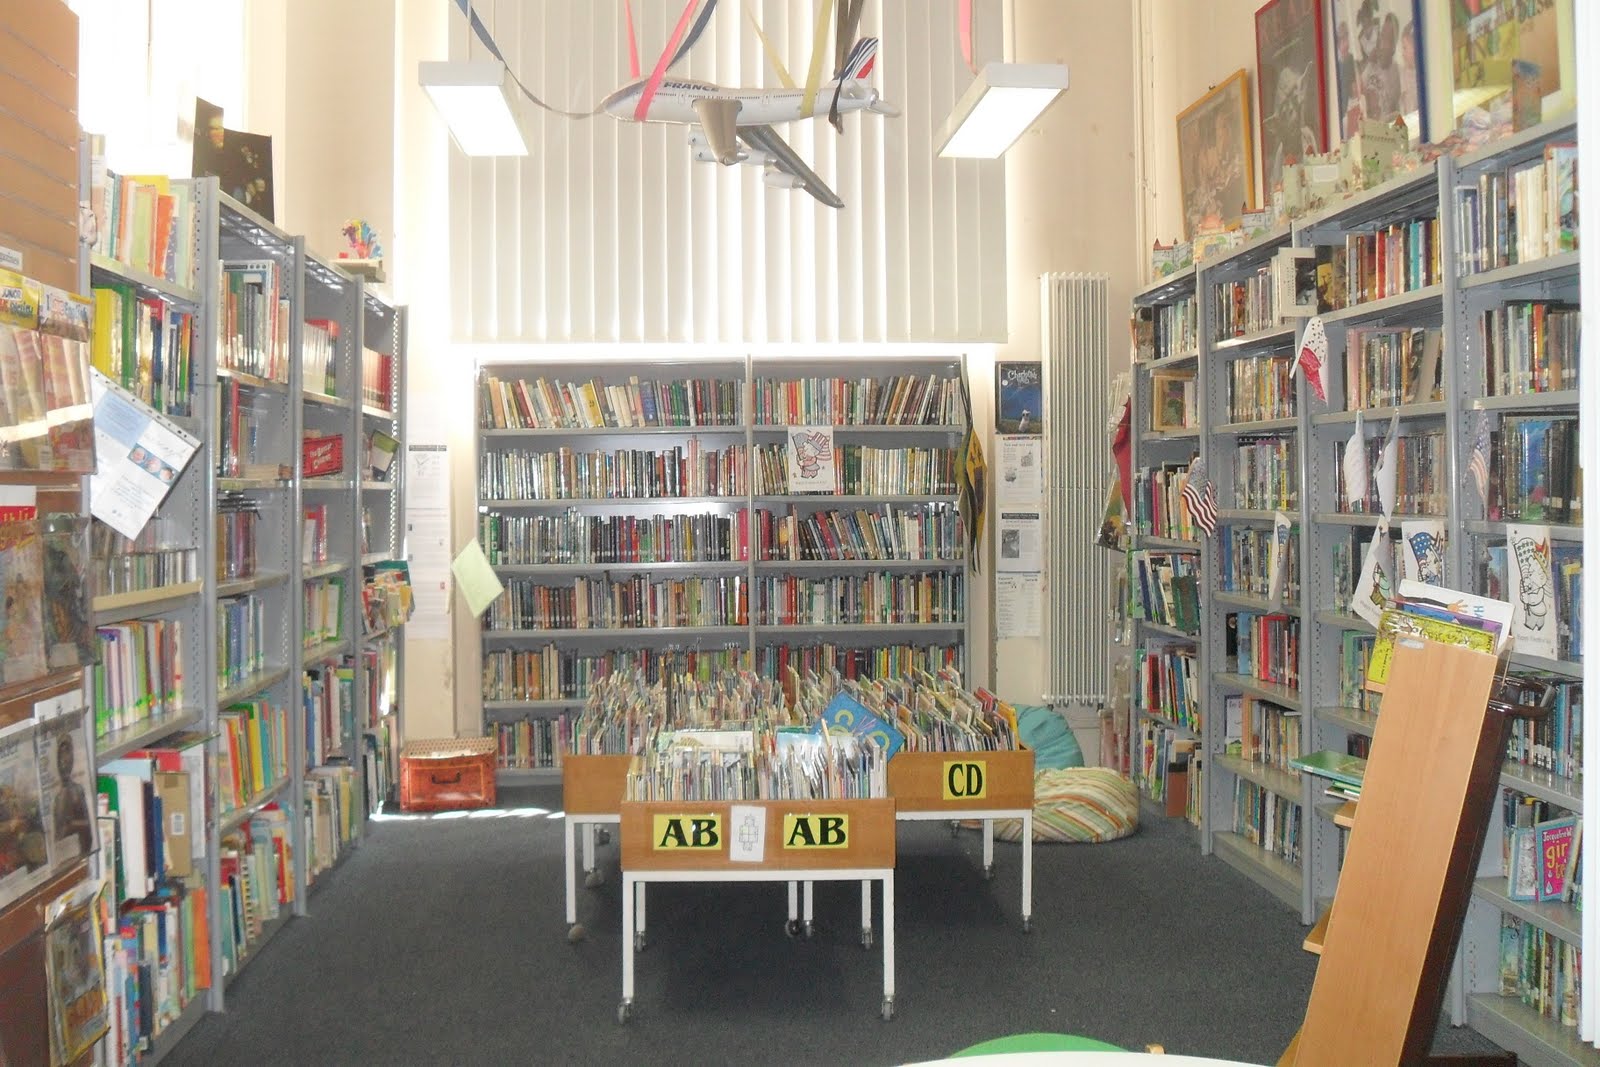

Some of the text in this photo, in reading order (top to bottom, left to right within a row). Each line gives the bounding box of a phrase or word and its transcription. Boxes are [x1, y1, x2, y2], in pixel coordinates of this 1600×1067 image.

[664, 82, 719, 91] FRANCE
[948, 764, 983, 797] CD
[659, 819, 719, 847] AB
[786, 818, 846, 846] AB
